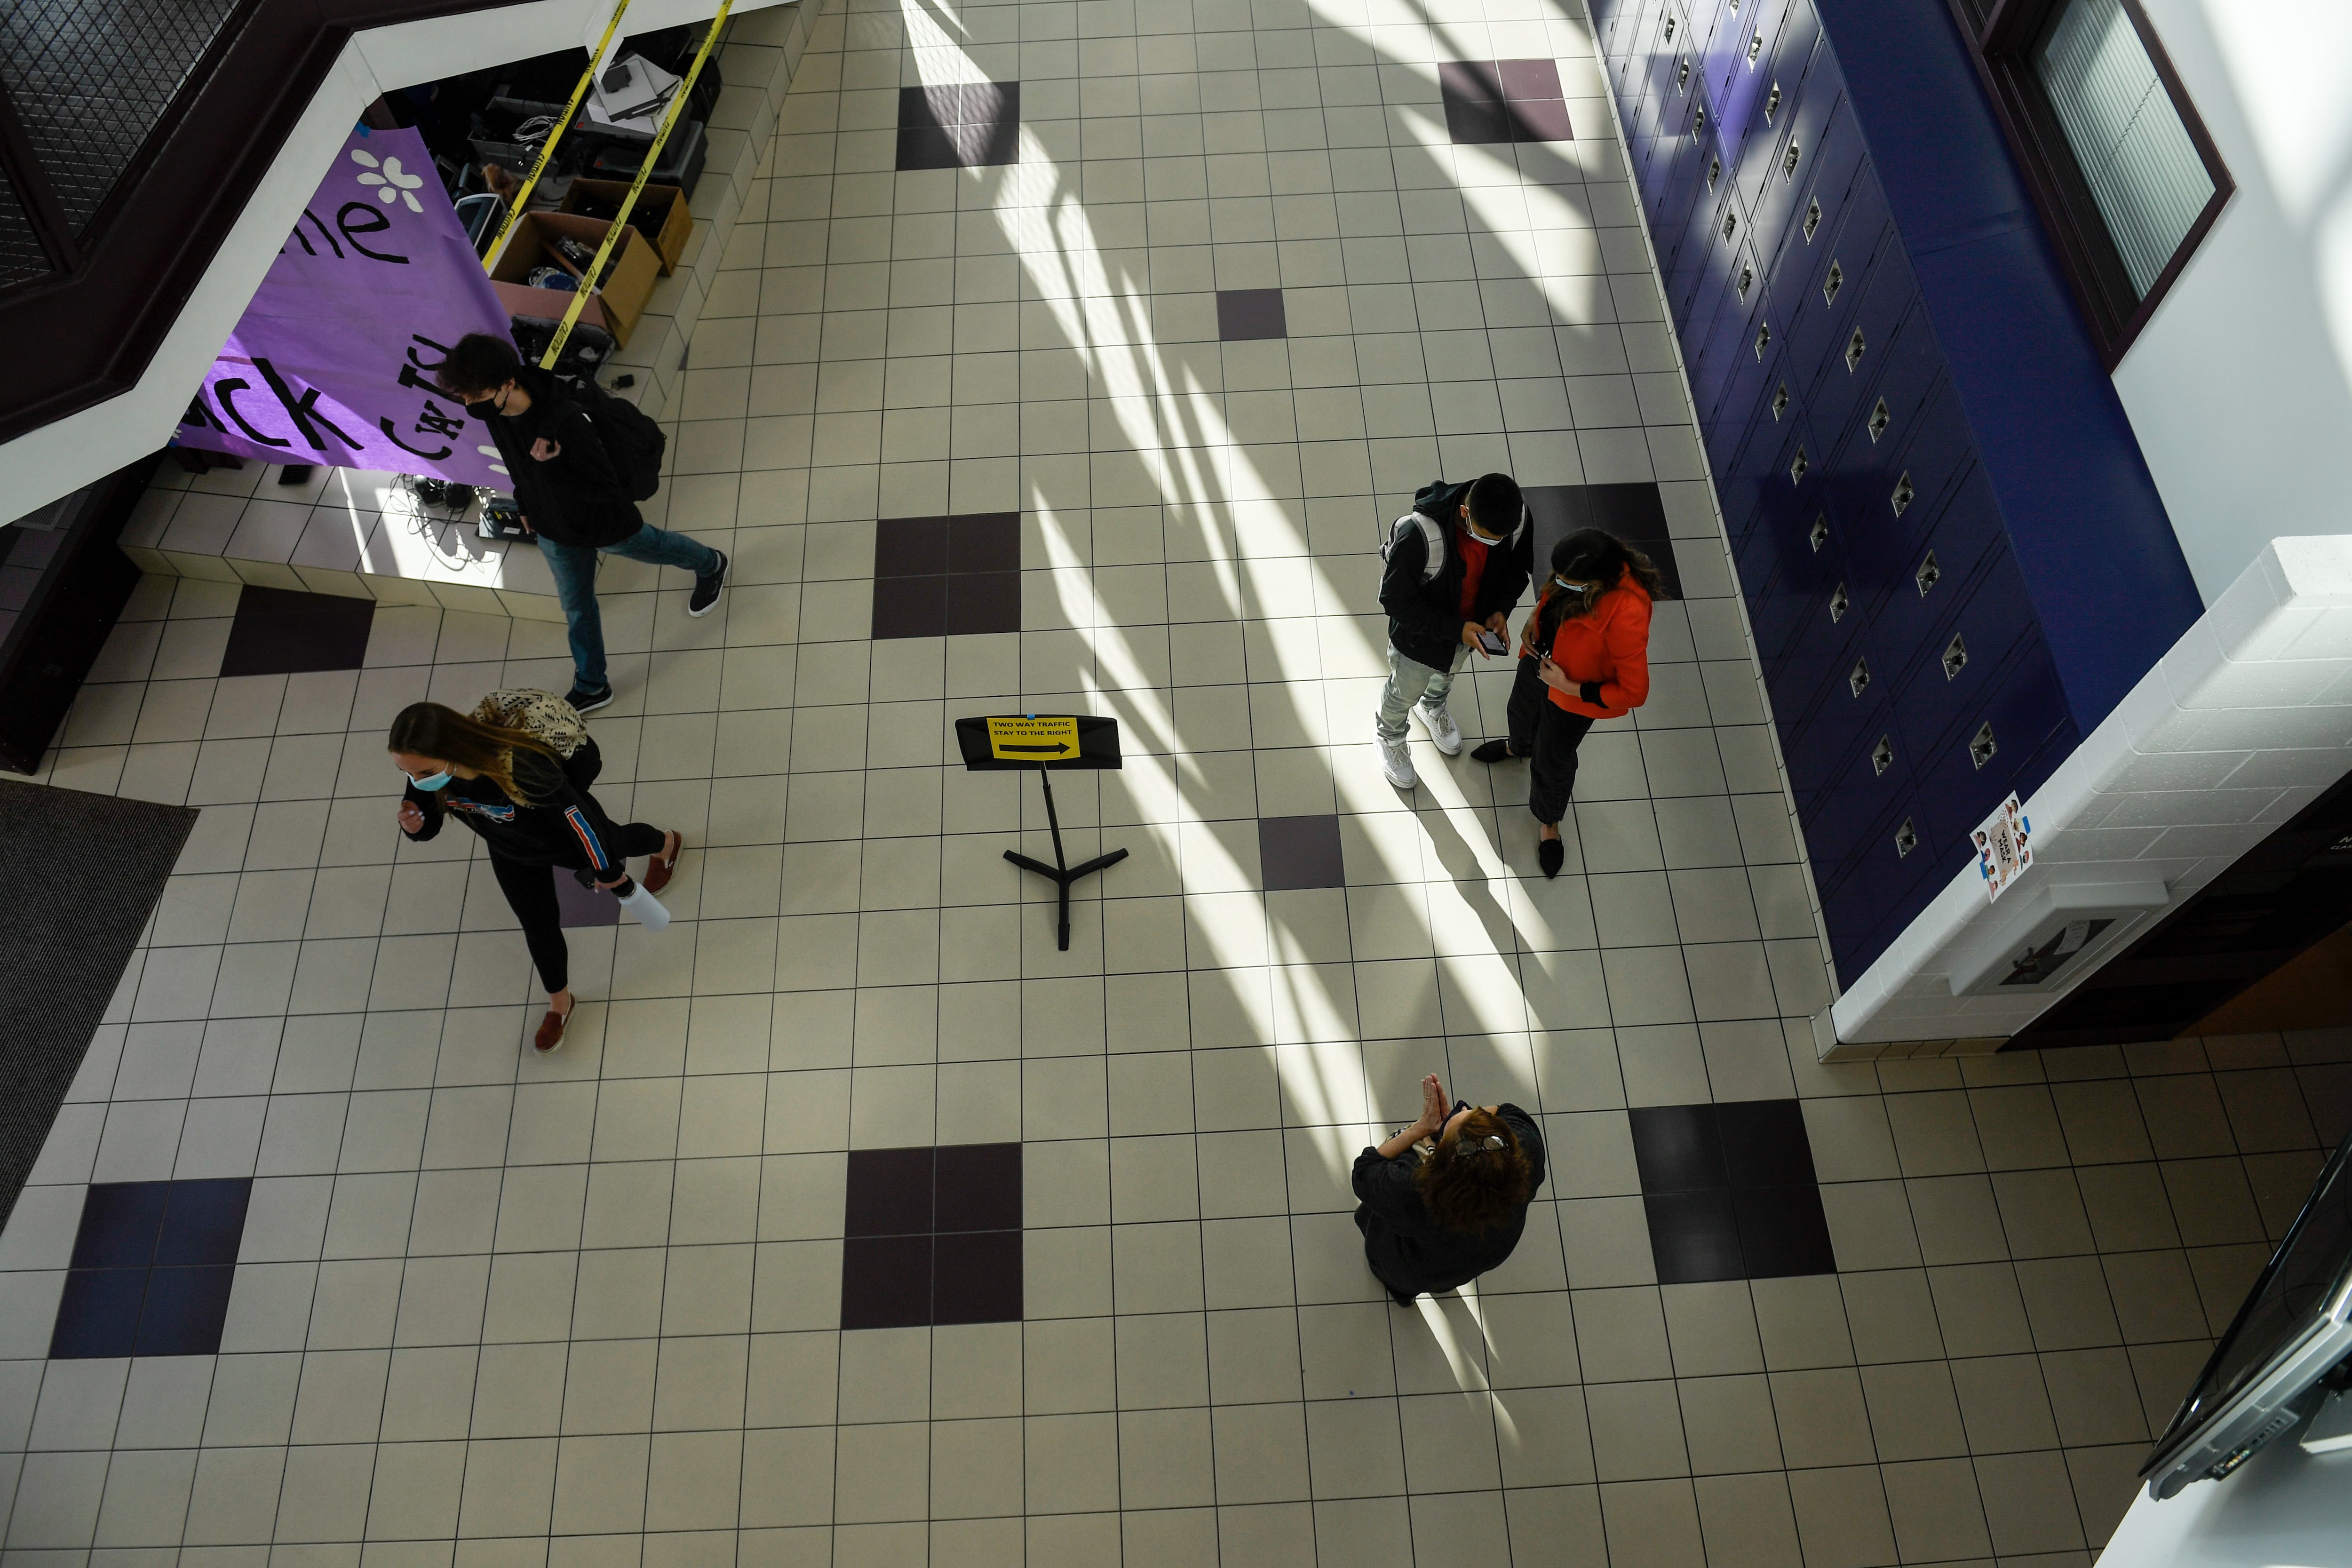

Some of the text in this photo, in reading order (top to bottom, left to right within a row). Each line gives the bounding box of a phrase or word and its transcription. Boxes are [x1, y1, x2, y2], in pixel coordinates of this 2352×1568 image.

[605, 214, 621, 246] CAUTION
[579, 265, 596, 299] CAUTION
[551, 321, 568, 356] CAUTION
[1998, 838, 2006, 864] MASK
[2001, 829, 2010, 855] WEAR
